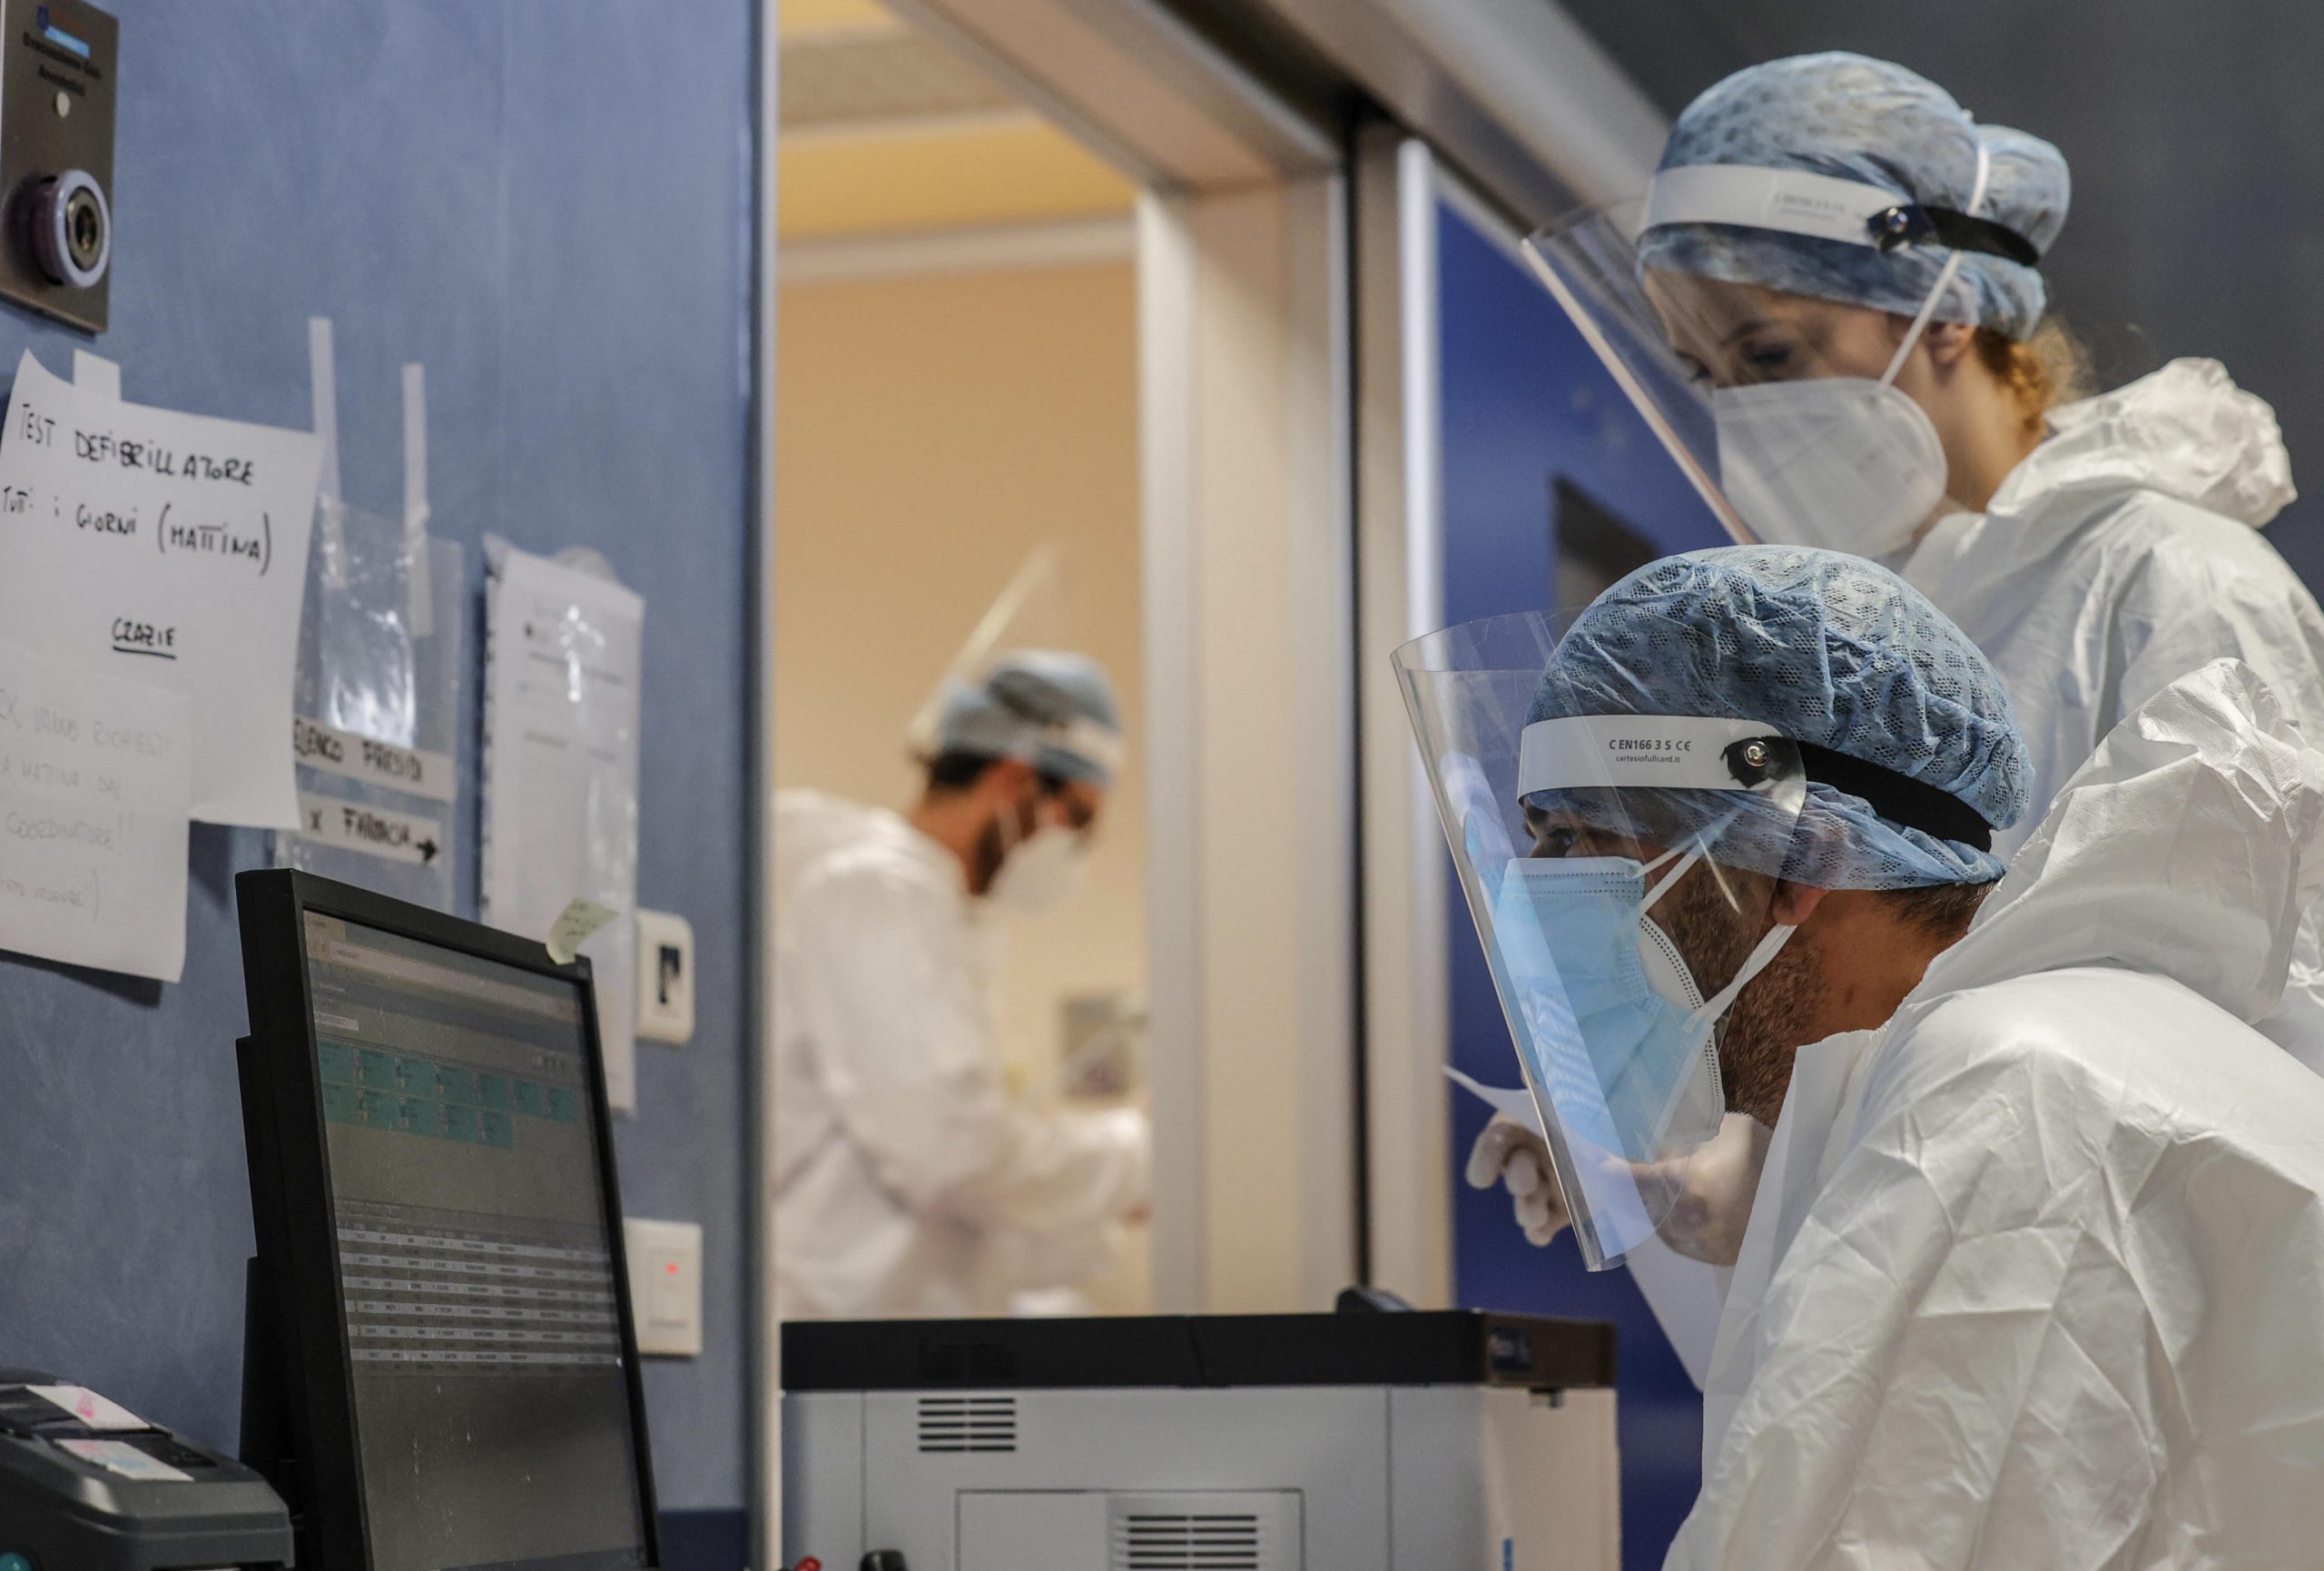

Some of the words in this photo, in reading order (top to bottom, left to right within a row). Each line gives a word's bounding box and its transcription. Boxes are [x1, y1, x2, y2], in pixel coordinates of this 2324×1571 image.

[20, 403, 55, 447] TEST
[1619, 739, 1652, 750] EN166
[1655, 739, 1661, 750] 3
[1665, 740, 1671, 751] S
[1616, 755, 1680, 764] cartesiofullcard.it
